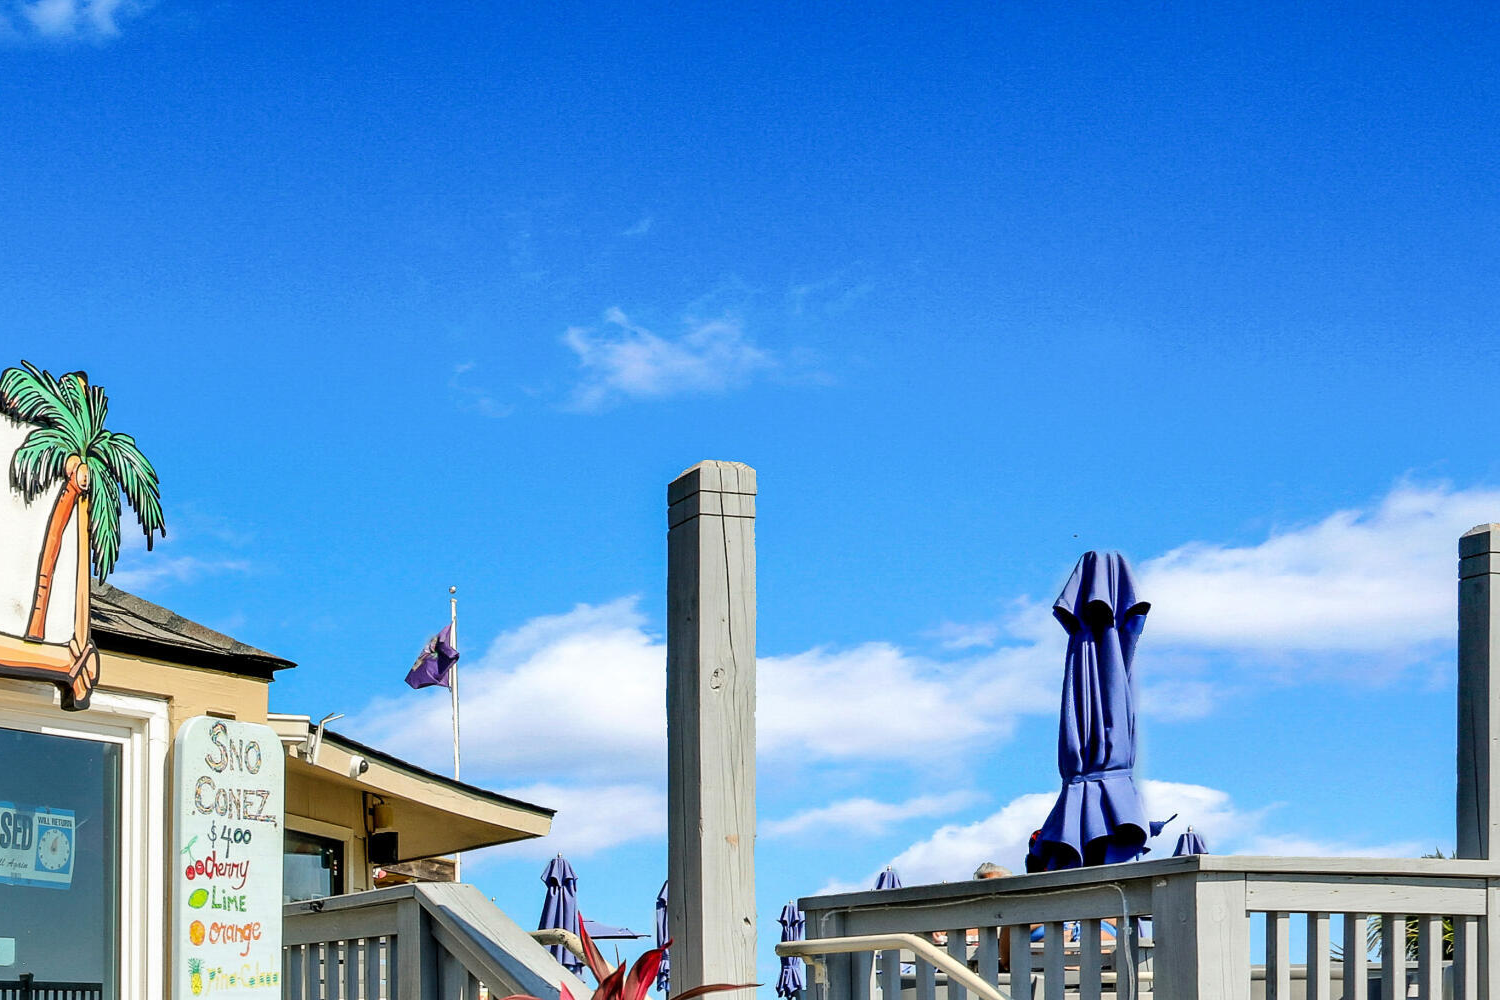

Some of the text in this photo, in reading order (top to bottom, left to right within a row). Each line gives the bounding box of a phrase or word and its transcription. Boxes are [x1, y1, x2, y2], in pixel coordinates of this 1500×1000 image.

[205, 720, 263, 775] SNO
[194, 775, 277, 822] CONEZ
[38, 816, 73, 828] WILL RETURN
[207, 820, 252, 858] $4.00
[7, 858, 28, 871] Again
[205, 850, 250, 890] Cherry
